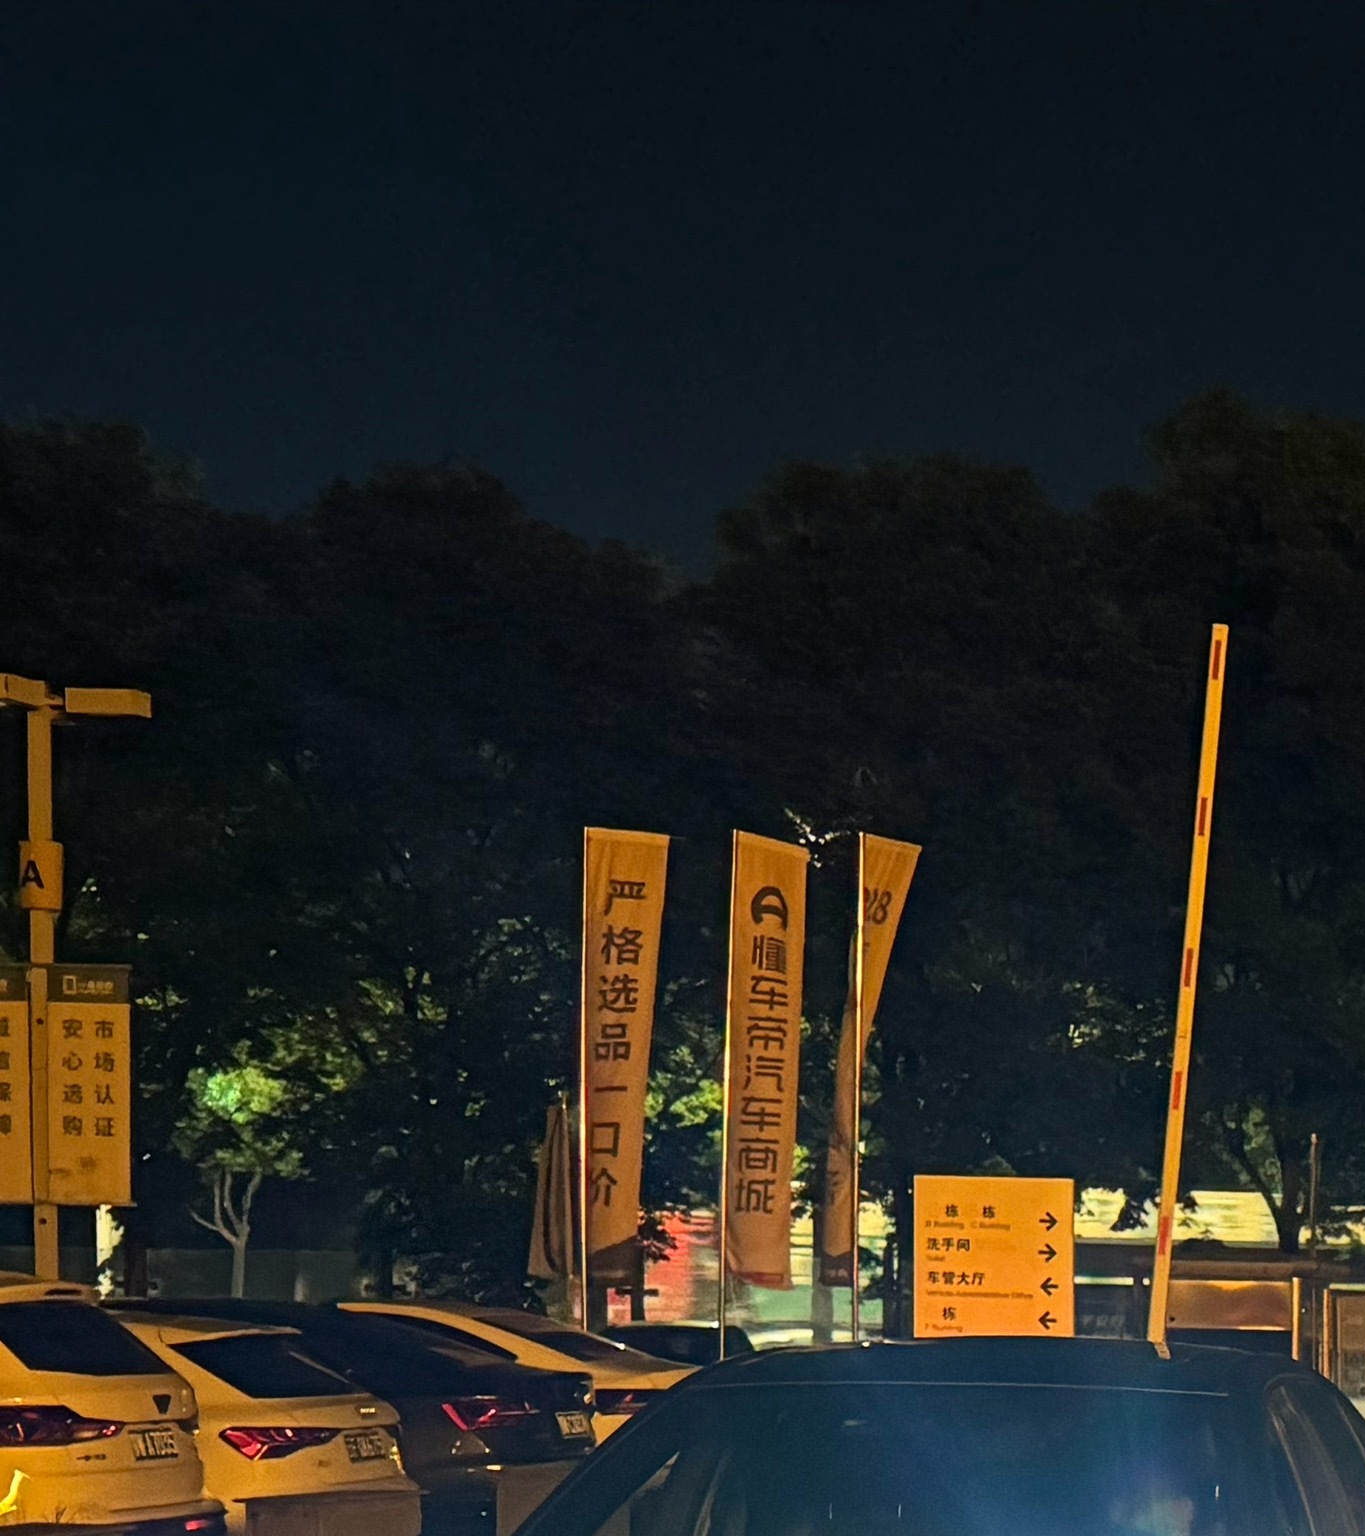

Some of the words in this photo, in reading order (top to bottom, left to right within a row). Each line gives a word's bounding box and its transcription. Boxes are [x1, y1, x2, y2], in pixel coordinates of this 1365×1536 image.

[21, 859, 45, 889] A
[93, 1020, 116, 1137] 市场认证
[588, 879, 647, 1208] 严格选品一口价
[734, 936, 789, 1217] 懂车帝汽车商城
[927, 1237, 971, 1252] 洗手间
[927, 1271, 986, 1286] 车管大厅
